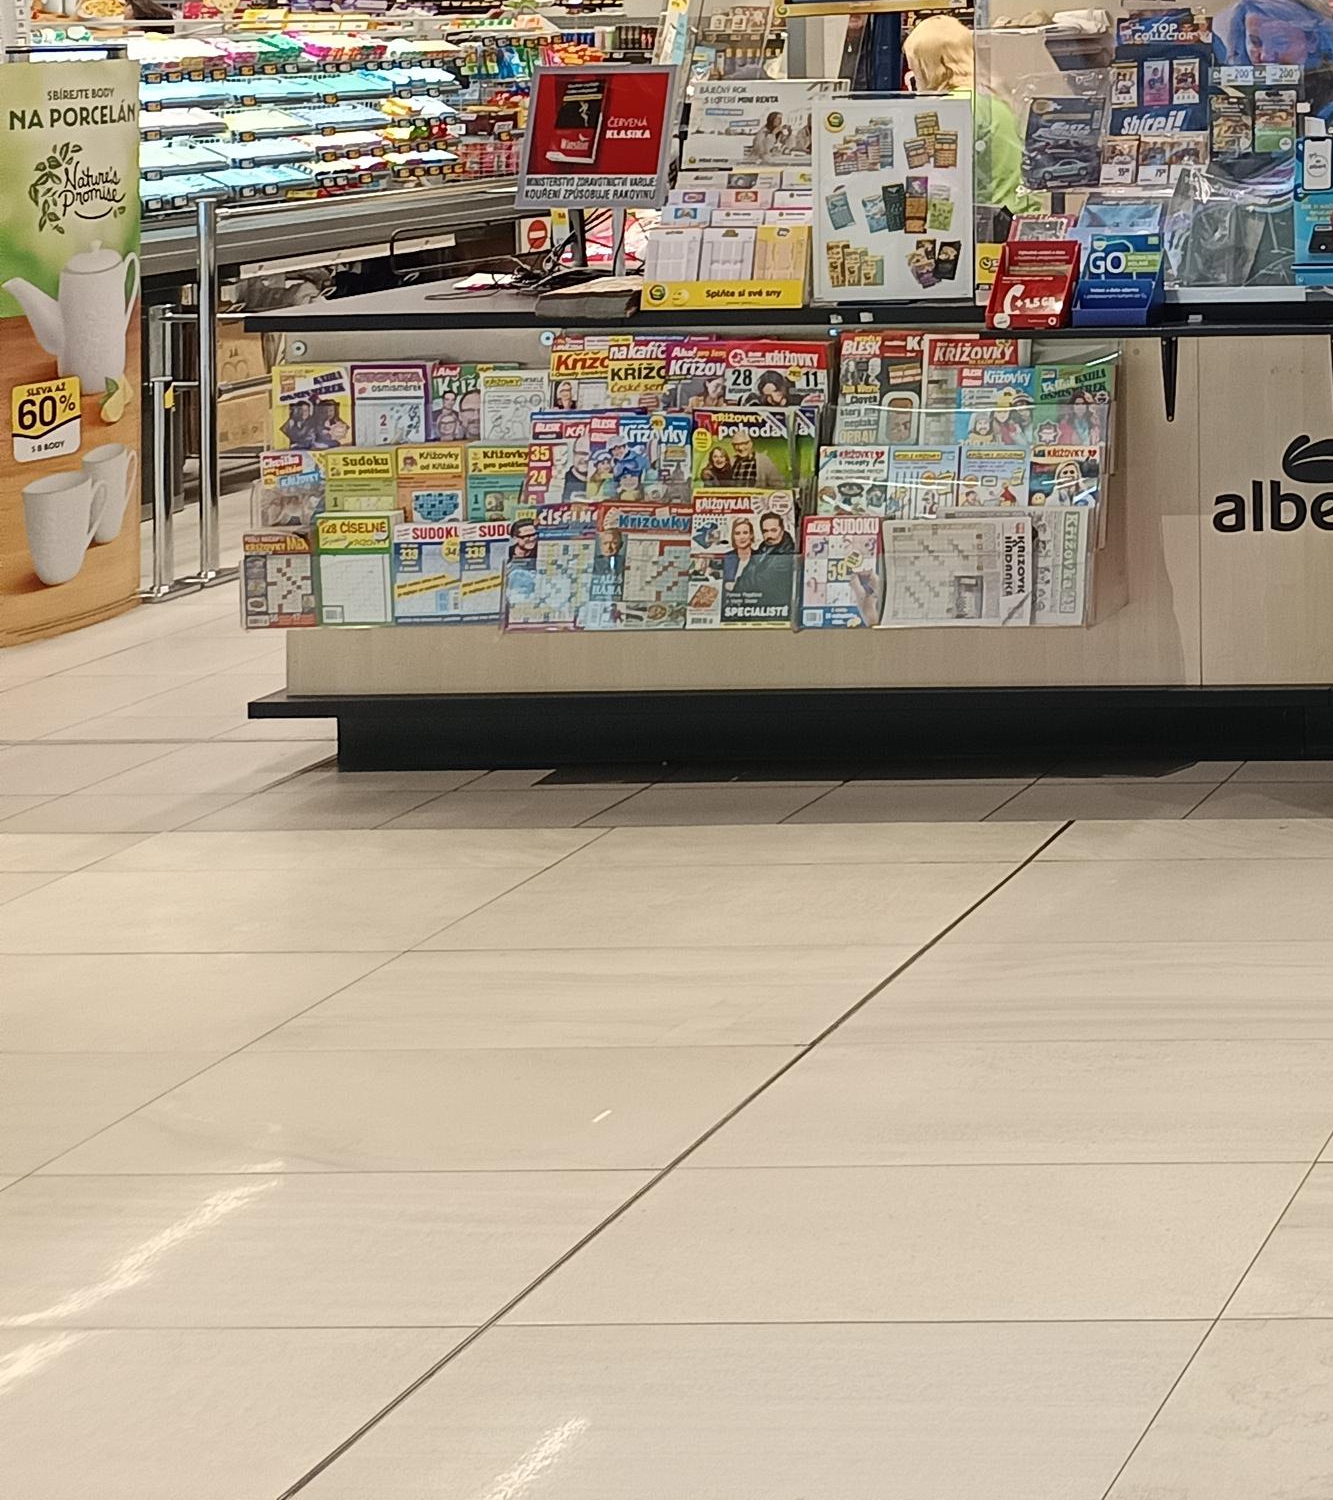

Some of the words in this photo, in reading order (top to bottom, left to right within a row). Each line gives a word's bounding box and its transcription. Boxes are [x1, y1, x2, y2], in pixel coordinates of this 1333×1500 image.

[1151, 23, 1178, 33] TOP
[1134, 32, 1195, 41] COLLECTOR
[47, 88, 89, 101] SBÍREJTE
[91, 87, 114, 99] BODY
[755, 95, 779, 104] RENTA
[9, 109, 44, 130] NA
[50, 99, 136, 128] PORCELÁN
[607, 116, 648, 128] ČERVENÁ
[1120, 110, 1186, 135] Sbírej!
[605, 130, 651, 139] KLASIKA
[64, 161, 121, 191] Nature's
[526, 177, 575, 187] MINISTERSTVO
[524, 188, 561, 200] KOUŘENÍ
[563, 188, 610, 200] ZPŮSOBUJE
[612, 188, 656, 200] RAKOVINU
[58, 187, 126, 217] Promise
[1089, 251, 1126, 274] GO
[738, 289, 746, 298] si
[748, 288, 763, 298] své
[765, 289, 782, 300] sny
[841, 341, 880, 355] BLESK
[933, 342, 1014, 363] KŘÍŽOVKY
[765, 351, 818, 367] KŘÍŽOVKY
[732, 369, 752, 387] 28
[803, 370, 818, 387] 11
[983, 368, 1032, 385] Křížovky
[26, 386, 53, 398] SLEVA
[18, 393, 76, 431] 60%
[619, 425, 688, 447] Křížovky
[342, 455, 388, 467] Sudoku
[419, 450, 459, 462] Křížovky
[483, 449, 528, 462] Křížovky
[530, 446, 550, 461] 35
[530, 470, 546, 485] 24
[833, 518, 879, 535] SUDOKU
[827, 562, 847, 582] 59
